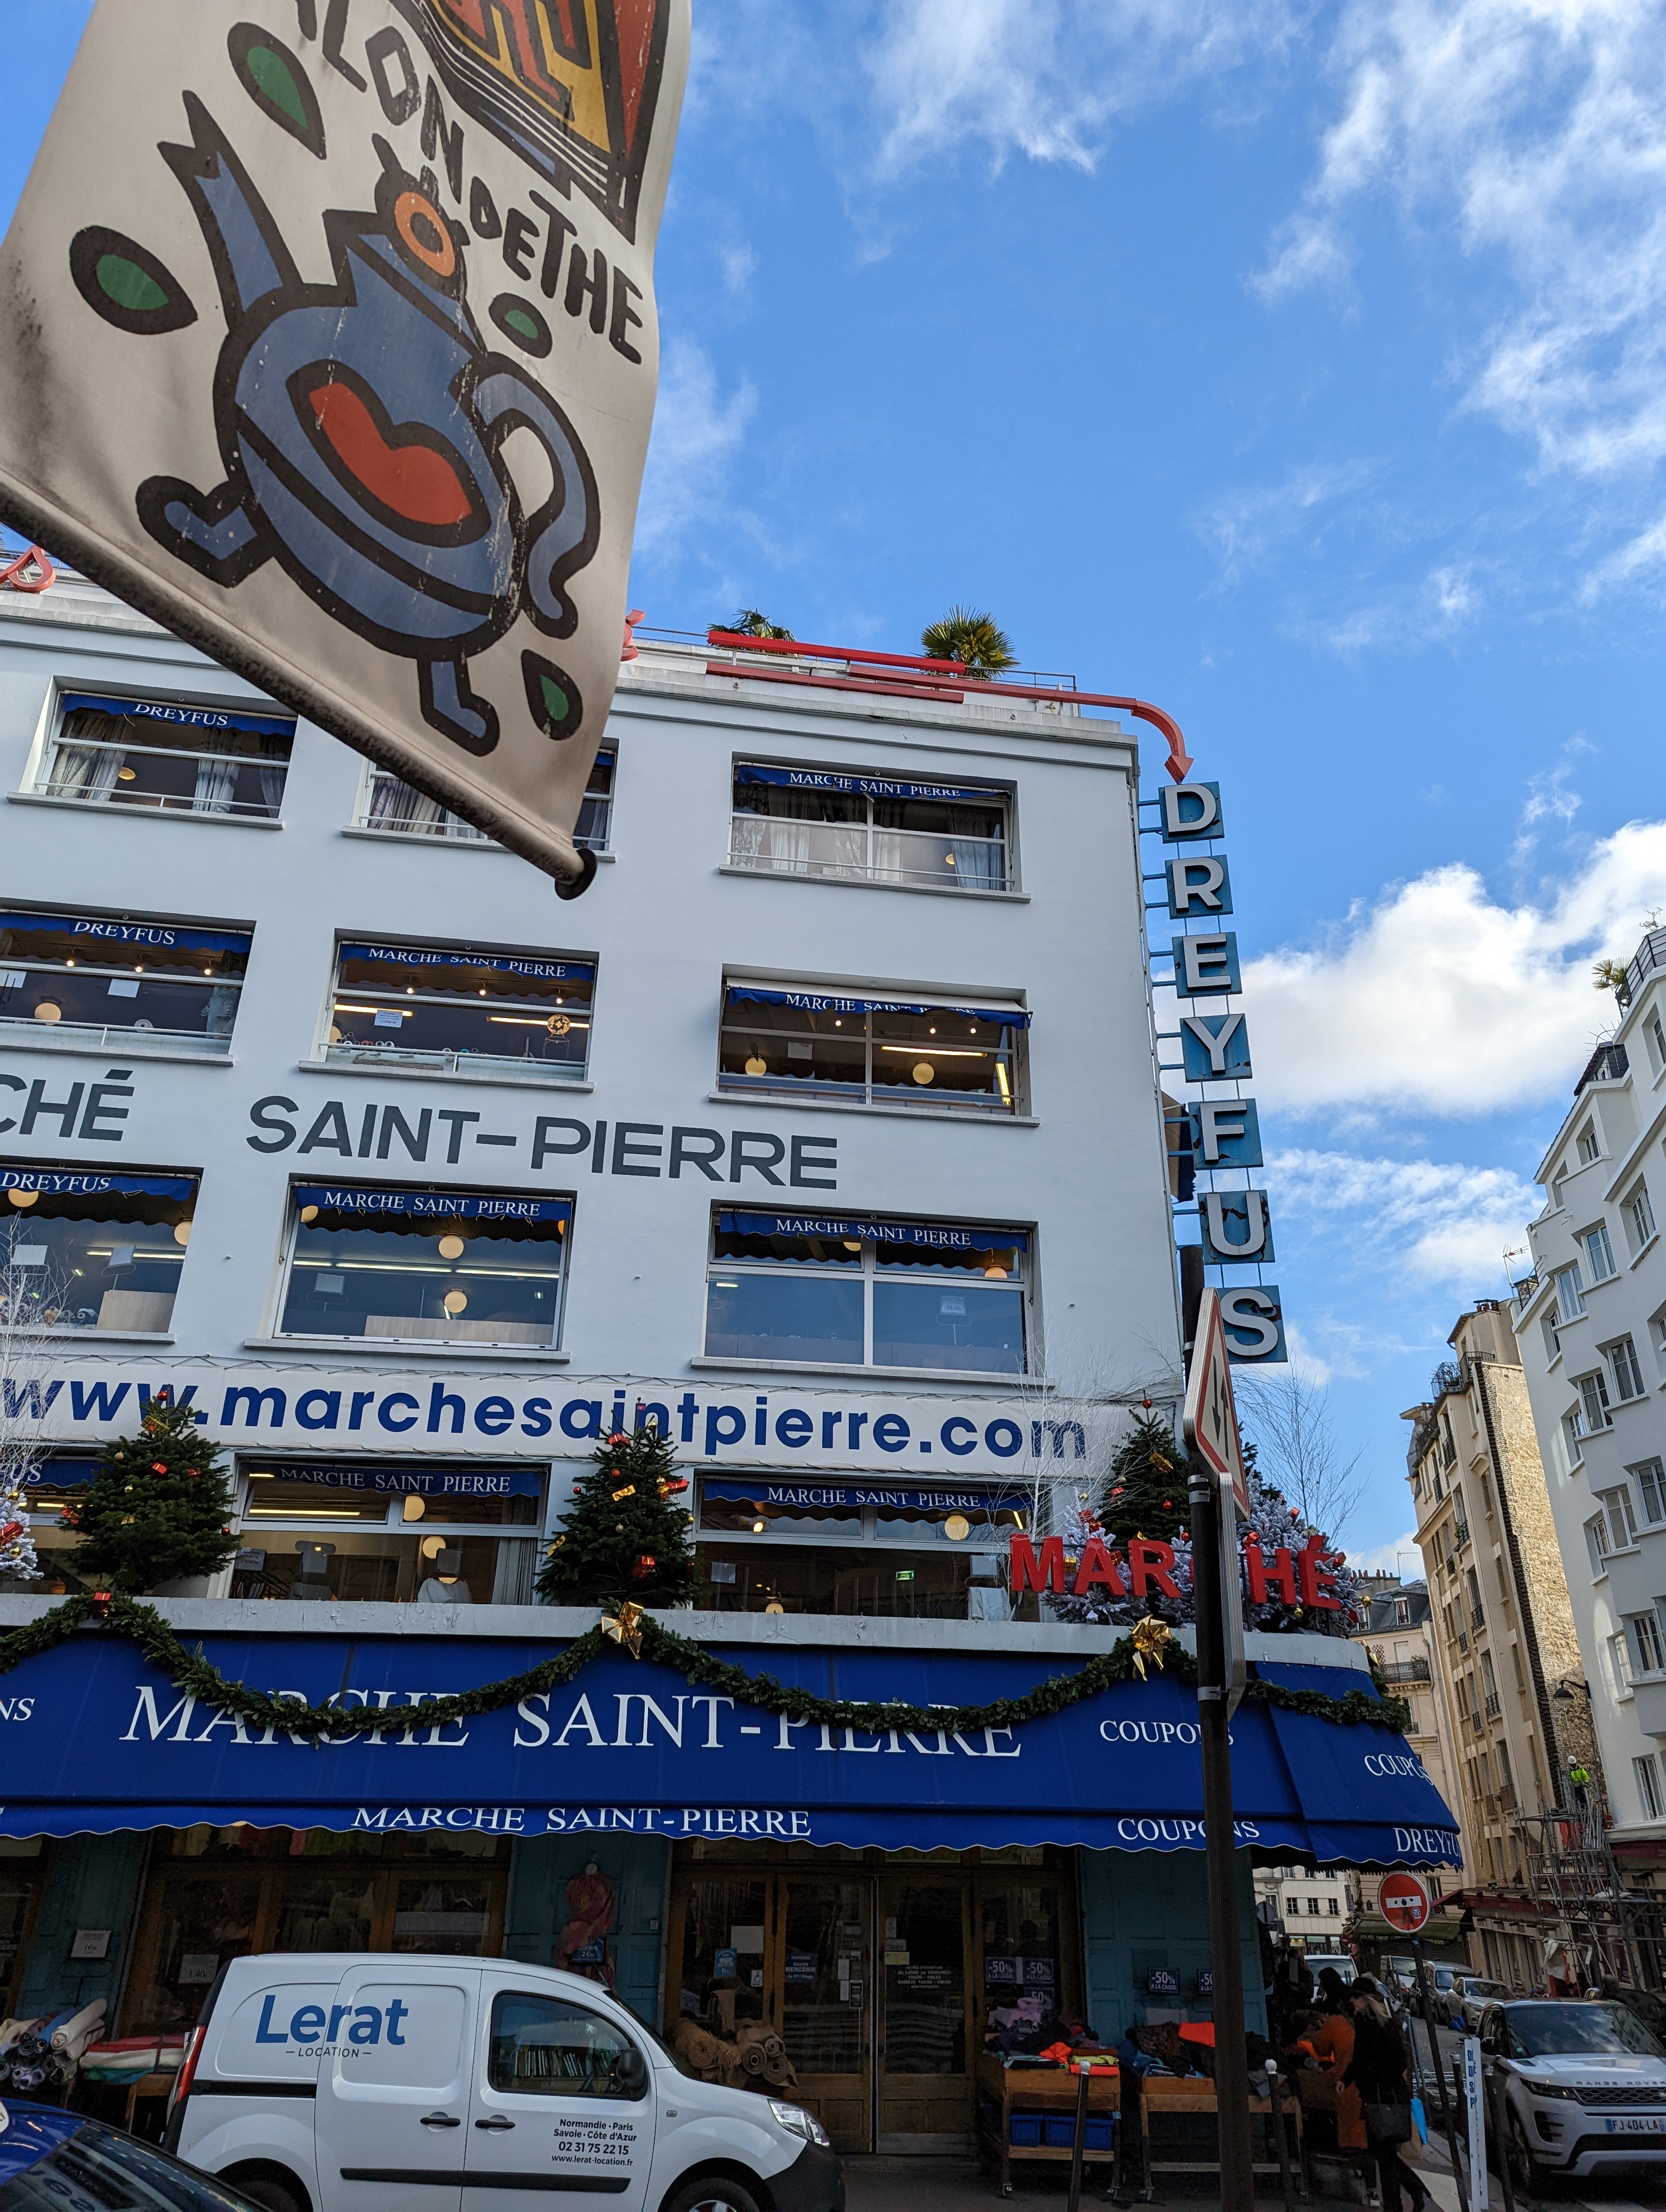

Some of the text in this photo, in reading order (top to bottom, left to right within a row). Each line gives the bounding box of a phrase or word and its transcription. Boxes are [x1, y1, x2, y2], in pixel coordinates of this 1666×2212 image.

[134, 701, 228, 728] DREYFUS
[790, 773, 960, 796] MARCHE SAINT PIERRE
[73, 922, 175, 946] DREYFUS
[368, 949, 566, 977] MARCHE SAINT PIERRE
[786, 994, 856, 1011] MARCHE
[1164, 782, 1278, 1356] DREYFUS
[2, 1172, 111, 1192] DREYFUS
[324, 1191, 540, 1217] MARCHE SAINT PIERRE
[776, 1218, 971, 1246] MARCHE SAINT PIERRE
[2, 1378, 1085, 1458] www.marchesaintpierre.com
[280, 1468, 510, 1492] MARCHE SAINT PIERRE
[767, 1487, 981, 1507] MARCHE SAINT PIERRE
[1010, 1533, 1341, 1610] MARHÉ
[351, 1807, 811, 1837] MARCHE SAINT-PIERRE
[989, 1960, 1013, 1973] -50%
[1152, 1971, 1176, 1984] -50%
[255, 1995, 408, 2046] Lerat
[298, 2047, 359, 2057] LOCATION
[554, 2129, 582, 2137] Savoie
[587, 2131, 607, 2139] Côte
[560, 2119, 633, 2131] Normandie Paris
[559, 2141, 629, 2155] 02 31 75 22 15
[552, 2155, 633, 2166] www.lerat-location.fr
